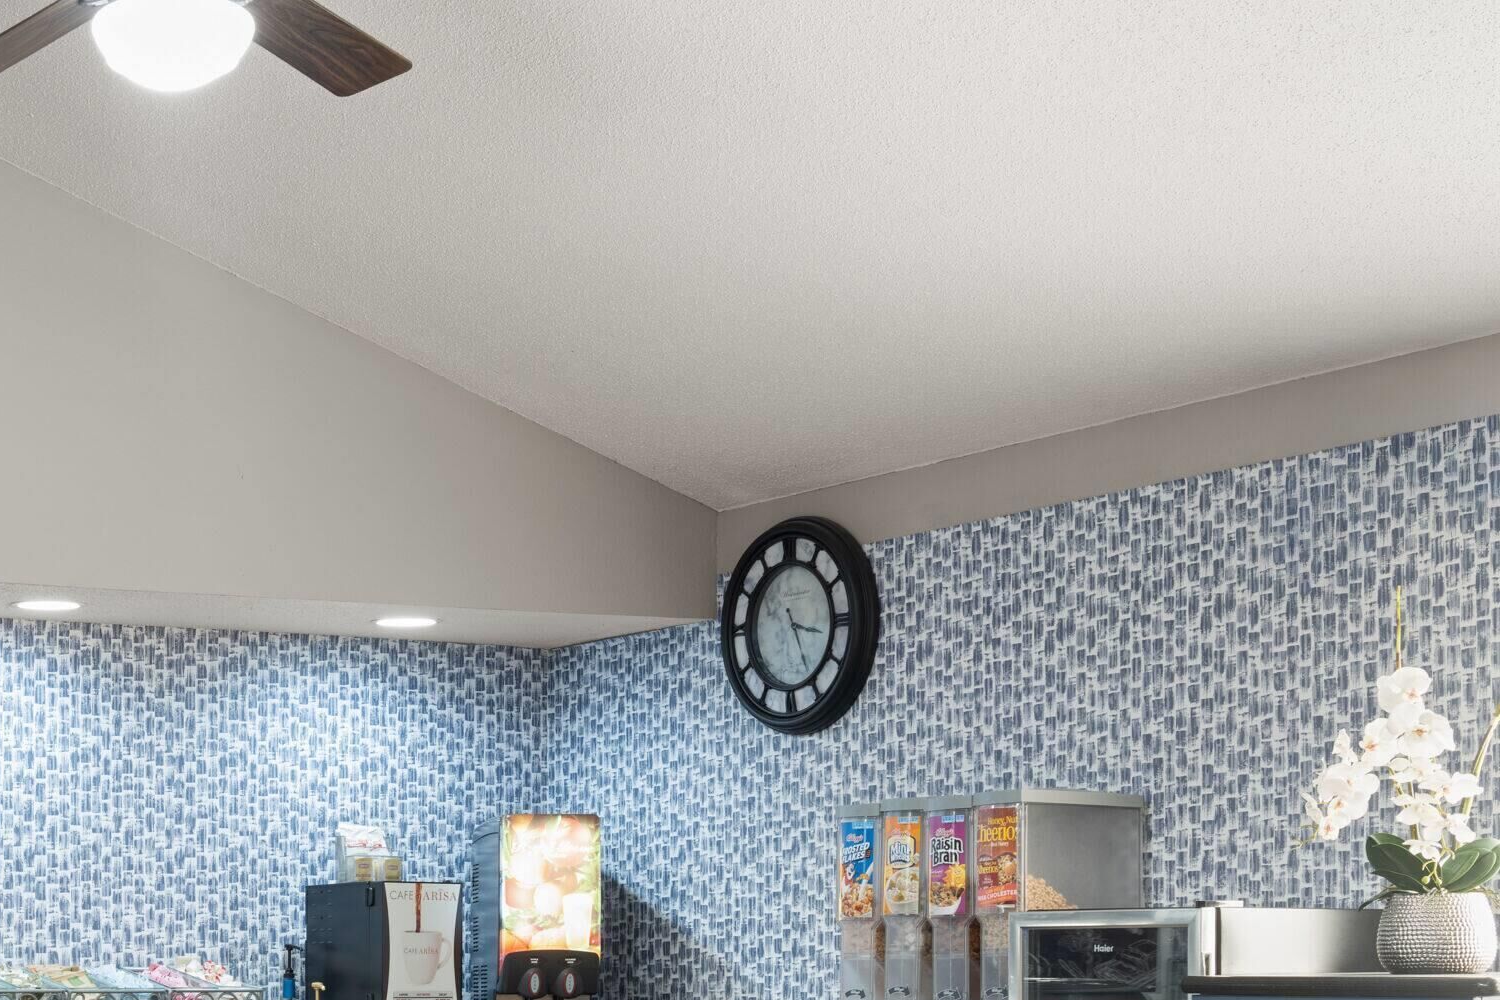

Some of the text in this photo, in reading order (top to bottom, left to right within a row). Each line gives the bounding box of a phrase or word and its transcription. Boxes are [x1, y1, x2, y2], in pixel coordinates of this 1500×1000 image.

[931, 837, 963, 852] Raisin
[933, 850, 959, 866] Bran
[1093, 944, 1114, 953] Haier
